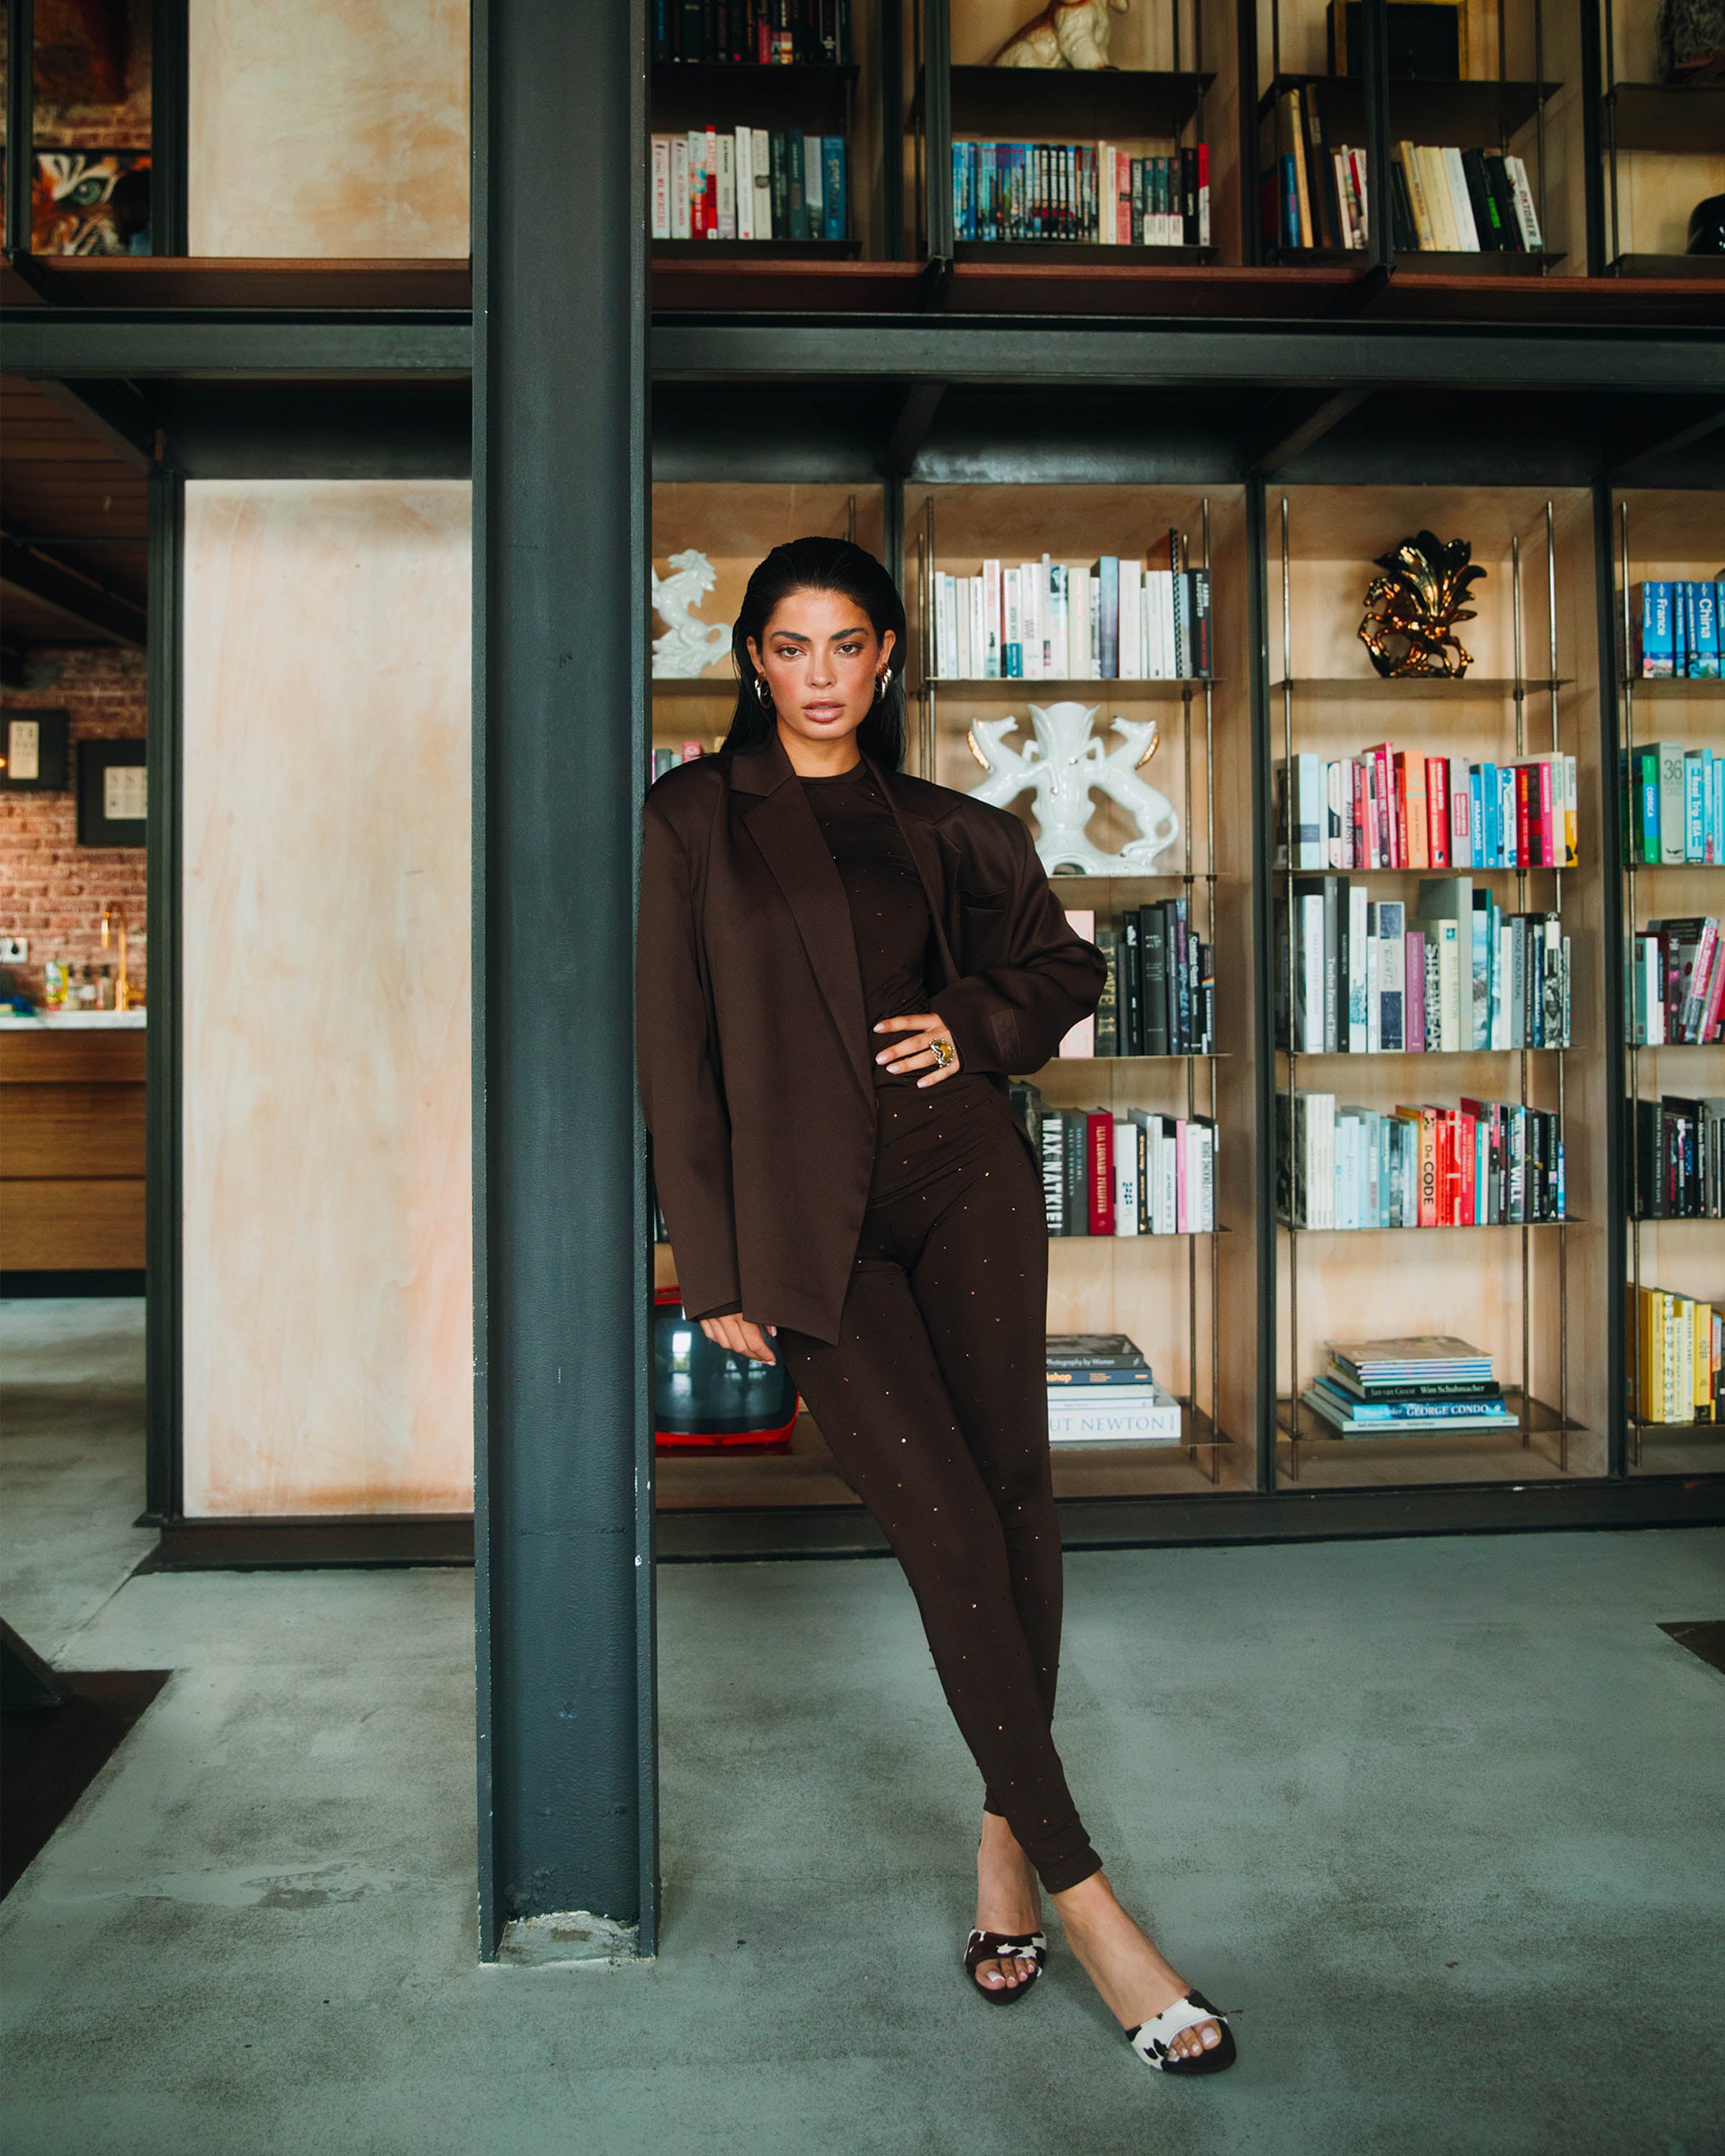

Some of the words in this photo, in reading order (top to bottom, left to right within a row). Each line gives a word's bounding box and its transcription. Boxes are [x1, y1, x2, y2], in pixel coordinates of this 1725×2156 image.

[1656, 598, 1668, 636] France
[1698, 598, 1713, 639] China
[1663, 759, 1683, 780] 36
[1327, 956, 1336, 986] Twelve
[1327, 988, 1336, 1013] Faces
[1327, 1013, 1336, 1023] of
[1327, 1025, 1336, 1047] Time
[1043, 1119, 1062, 1155] MAX
[1425, 1144, 1433, 1158] De
[1423, 1161, 1435, 1206] CODE
[1510, 1165, 1522, 1204] WILL
[1406, 1404, 1448, 1417] GEORGE
[1450, 1401, 1489, 1415] CONDO
[1081, 1416, 1164, 1432] NEWTON
